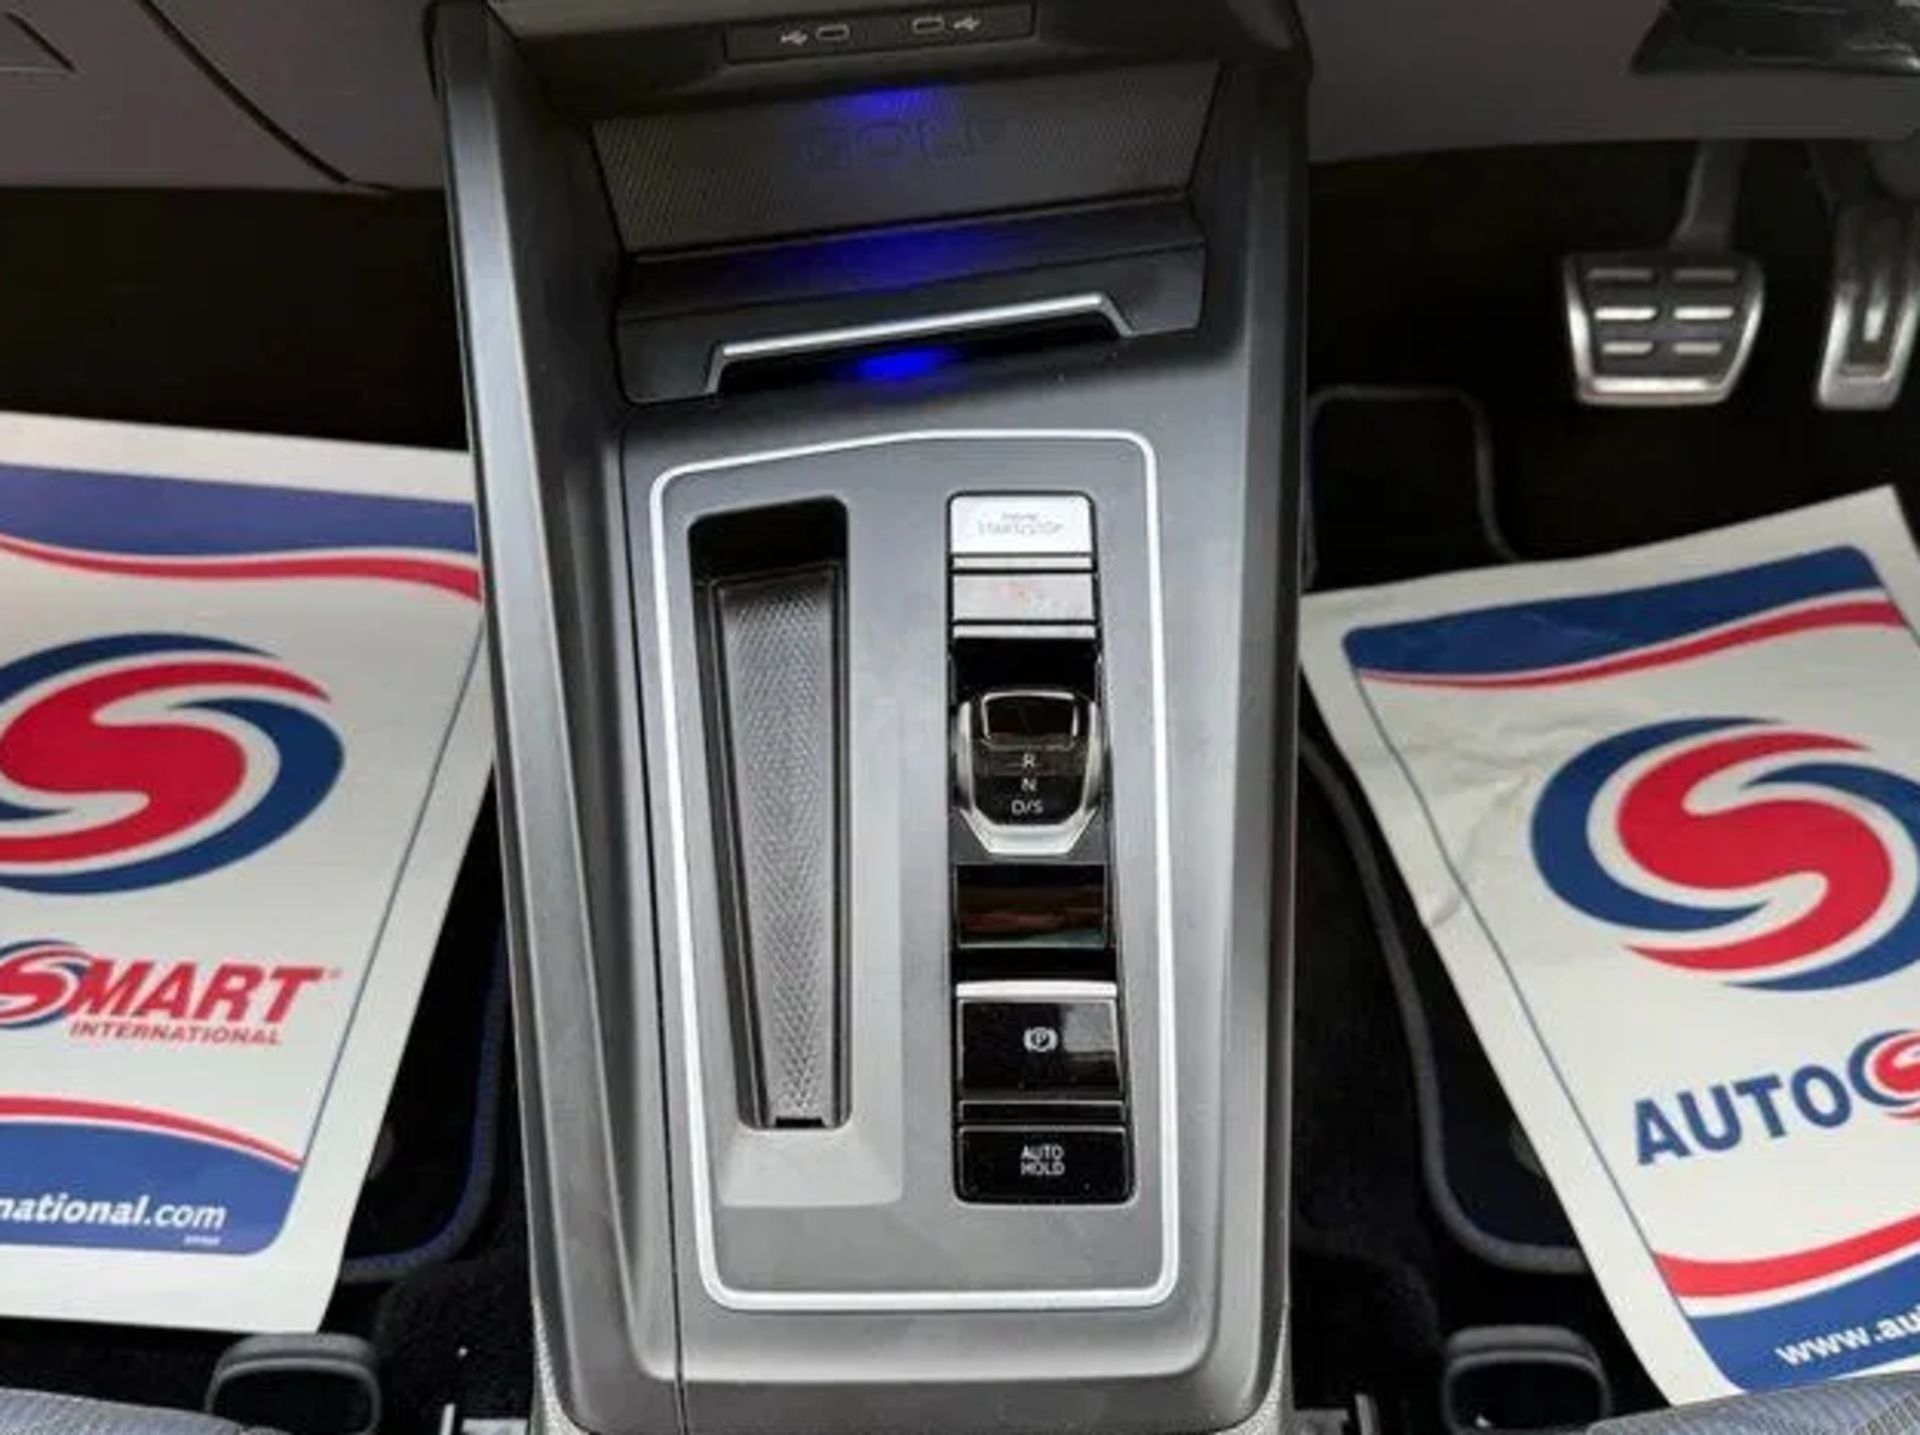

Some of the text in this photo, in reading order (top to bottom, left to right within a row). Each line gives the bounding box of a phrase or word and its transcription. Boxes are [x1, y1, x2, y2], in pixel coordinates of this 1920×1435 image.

[1022, 752, 1036, 768] R
[1021, 777, 1038, 792] N
[1011, 800, 1044, 815] D/S
[70, 1019, 283, 1046] INTERNATIONAL
[1020, 1144, 1065, 1161] AUTO
[1020, 1161, 1066, 1176] HOLD
